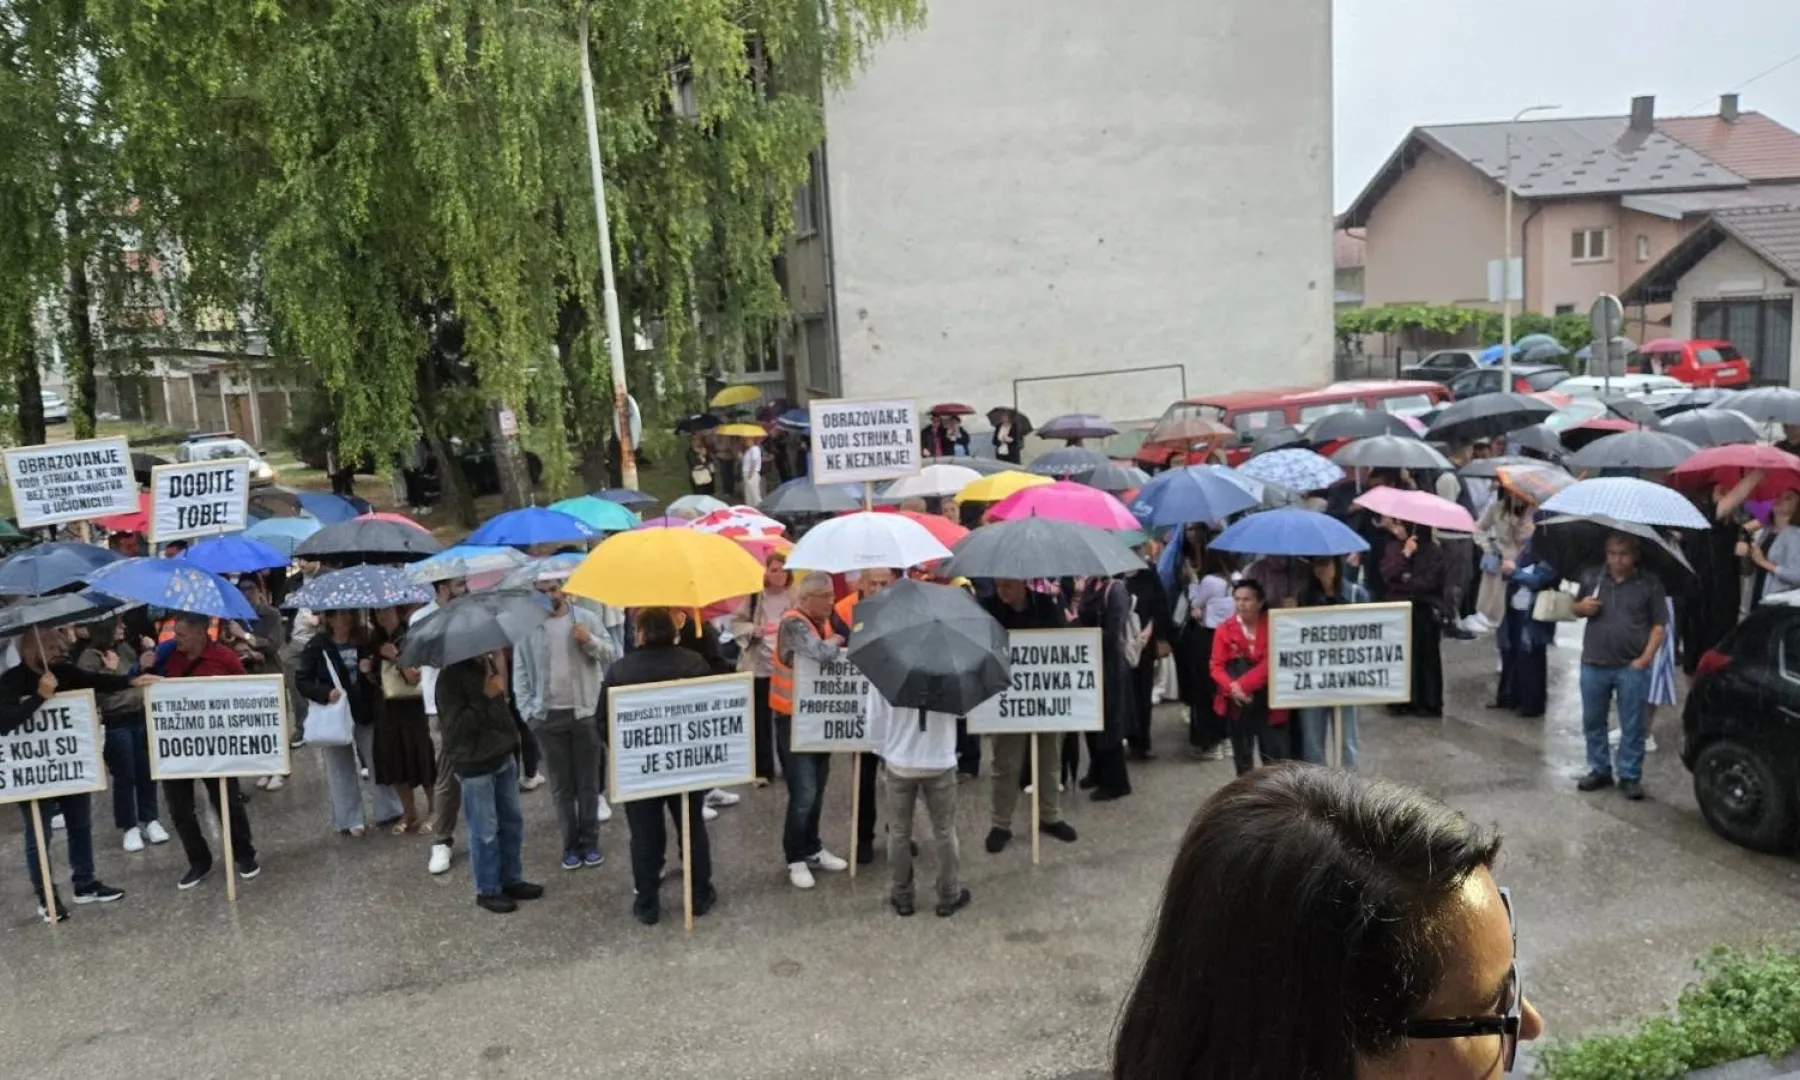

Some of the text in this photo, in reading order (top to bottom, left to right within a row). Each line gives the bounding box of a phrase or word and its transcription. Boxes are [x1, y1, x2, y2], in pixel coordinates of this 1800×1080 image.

[822, 408, 909, 428] OBRAZOVANJE
[820, 433, 849, 449] VODI
[905, 428, 913, 444] A
[18, 449, 119, 474] OBRAZOVANJE
[826, 450, 910, 470] NE NEZNANJE!
[16, 475, 40, 488] VODI
[86, 469, 93, 480] A
[96, 467, 108, 478] NE
[26, 480, 123, 501] BEZ DANA ISKUSTVA
[42, 503, 50, 514] U
[177, 501, 228, 530] TOBE!
[1301, 623, 1382, 644] PREGOVORI
[1010, 645, 1089, 665] AZOVANJE
[1279, 644, 1404, 669] NISU PREDSTAVA
[814, 676, 857, 695] TROŠAK
[1077, 671, 1095, 690] ZA
[1294, 669, 1390, 690] ZA JAVNOST!
[152, 701, 162, 712] NE
[166, 697, 206, 712] TRAŽIMO
[209, 699, 231, 711] NOVI
[712, 699, 722, 711] JE
[799, 699, 859, 714] PROFESOR
[999, 693, 1072, 717] ŠTEDNJU!
[153, 712, 280, 731] TRAŽIMO DA ISPUNITE
[623, 715, 743, 749] UREDITI SISTEM
[824, 715, 865, 739] DRUŠ
[10, 739, 51, 761] KOJI
[56, 735, 78, 756] SU
[158, 734, 279, 758] DOGOVORENO!
[641, 742, 728, 774] JE STRUKA!
[12, 758, 84, 788] NAUČILI!
